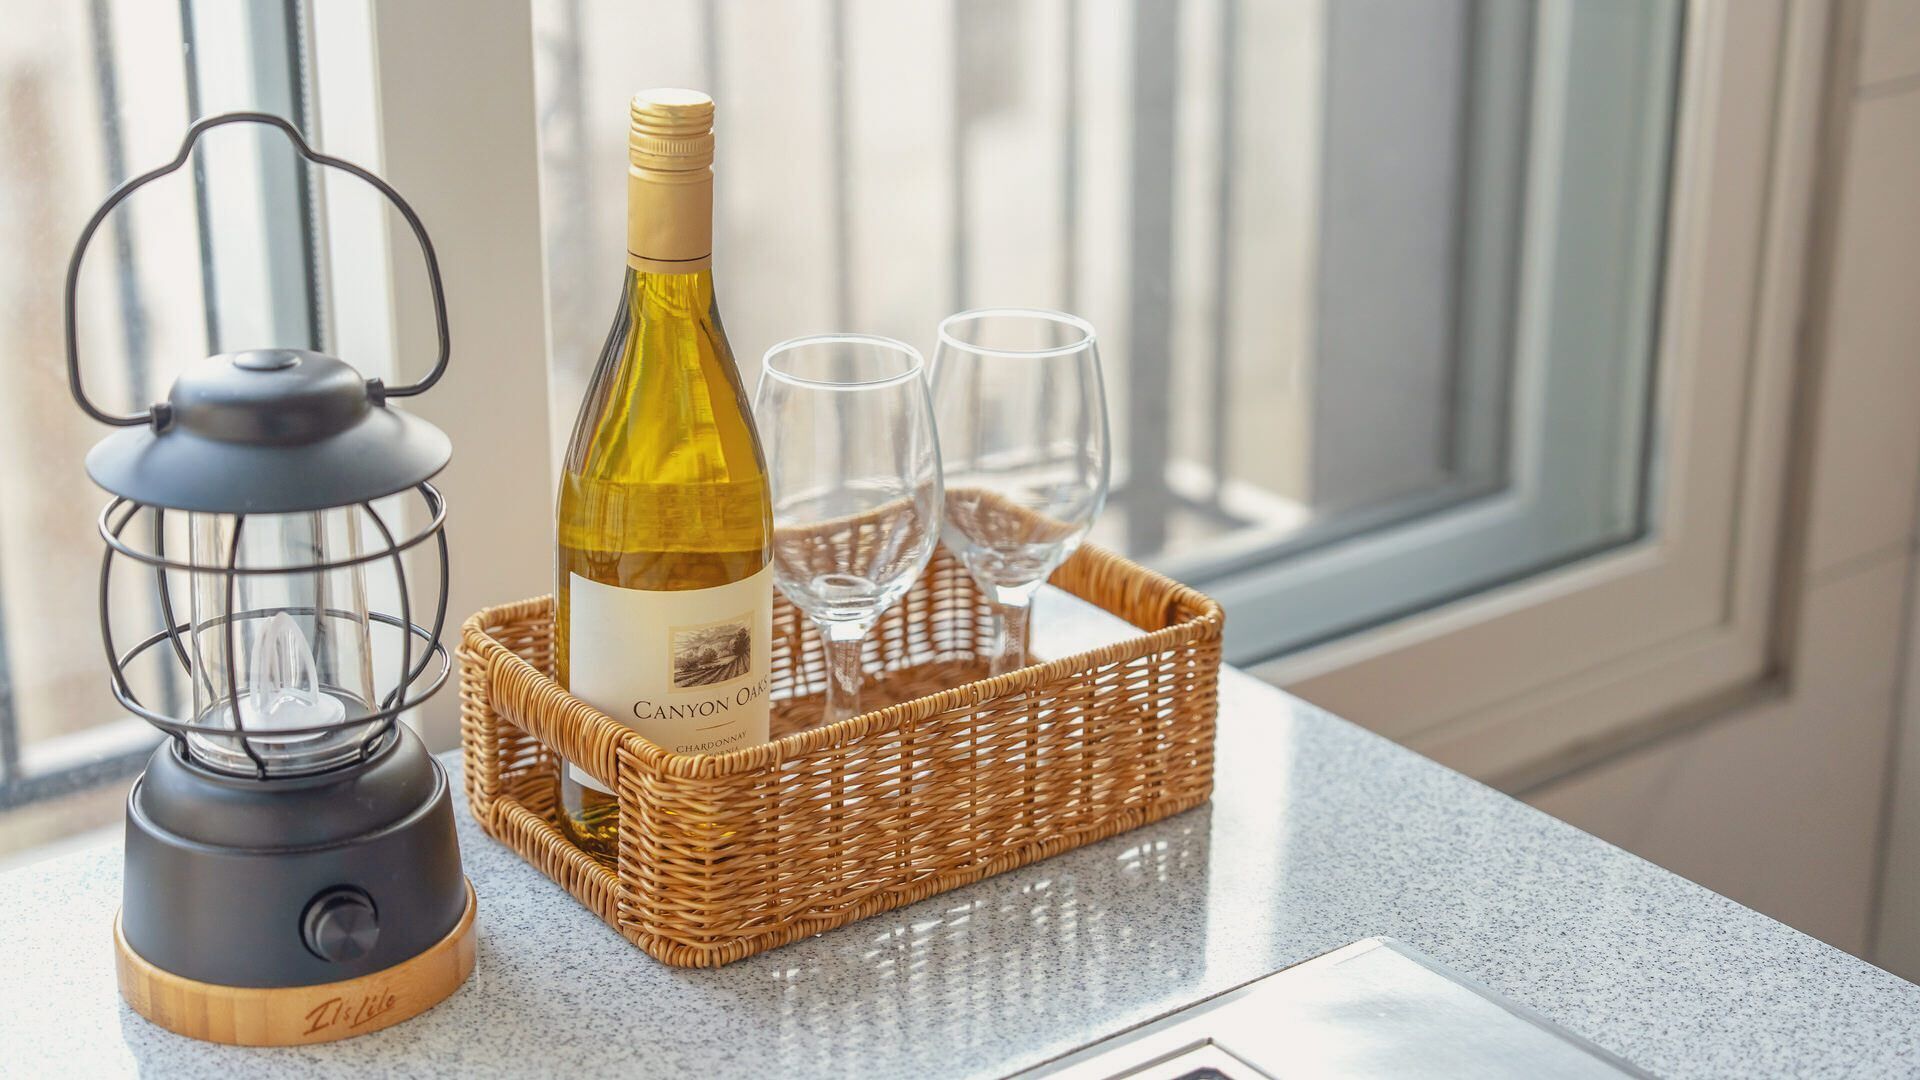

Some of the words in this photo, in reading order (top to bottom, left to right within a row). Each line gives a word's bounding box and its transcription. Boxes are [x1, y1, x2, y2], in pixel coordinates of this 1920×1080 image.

[633, 697, 729, 720] CANYON
[736, 675, 768, 706] OAKS
[676, 729, 747, 753] CHARDONNAY
